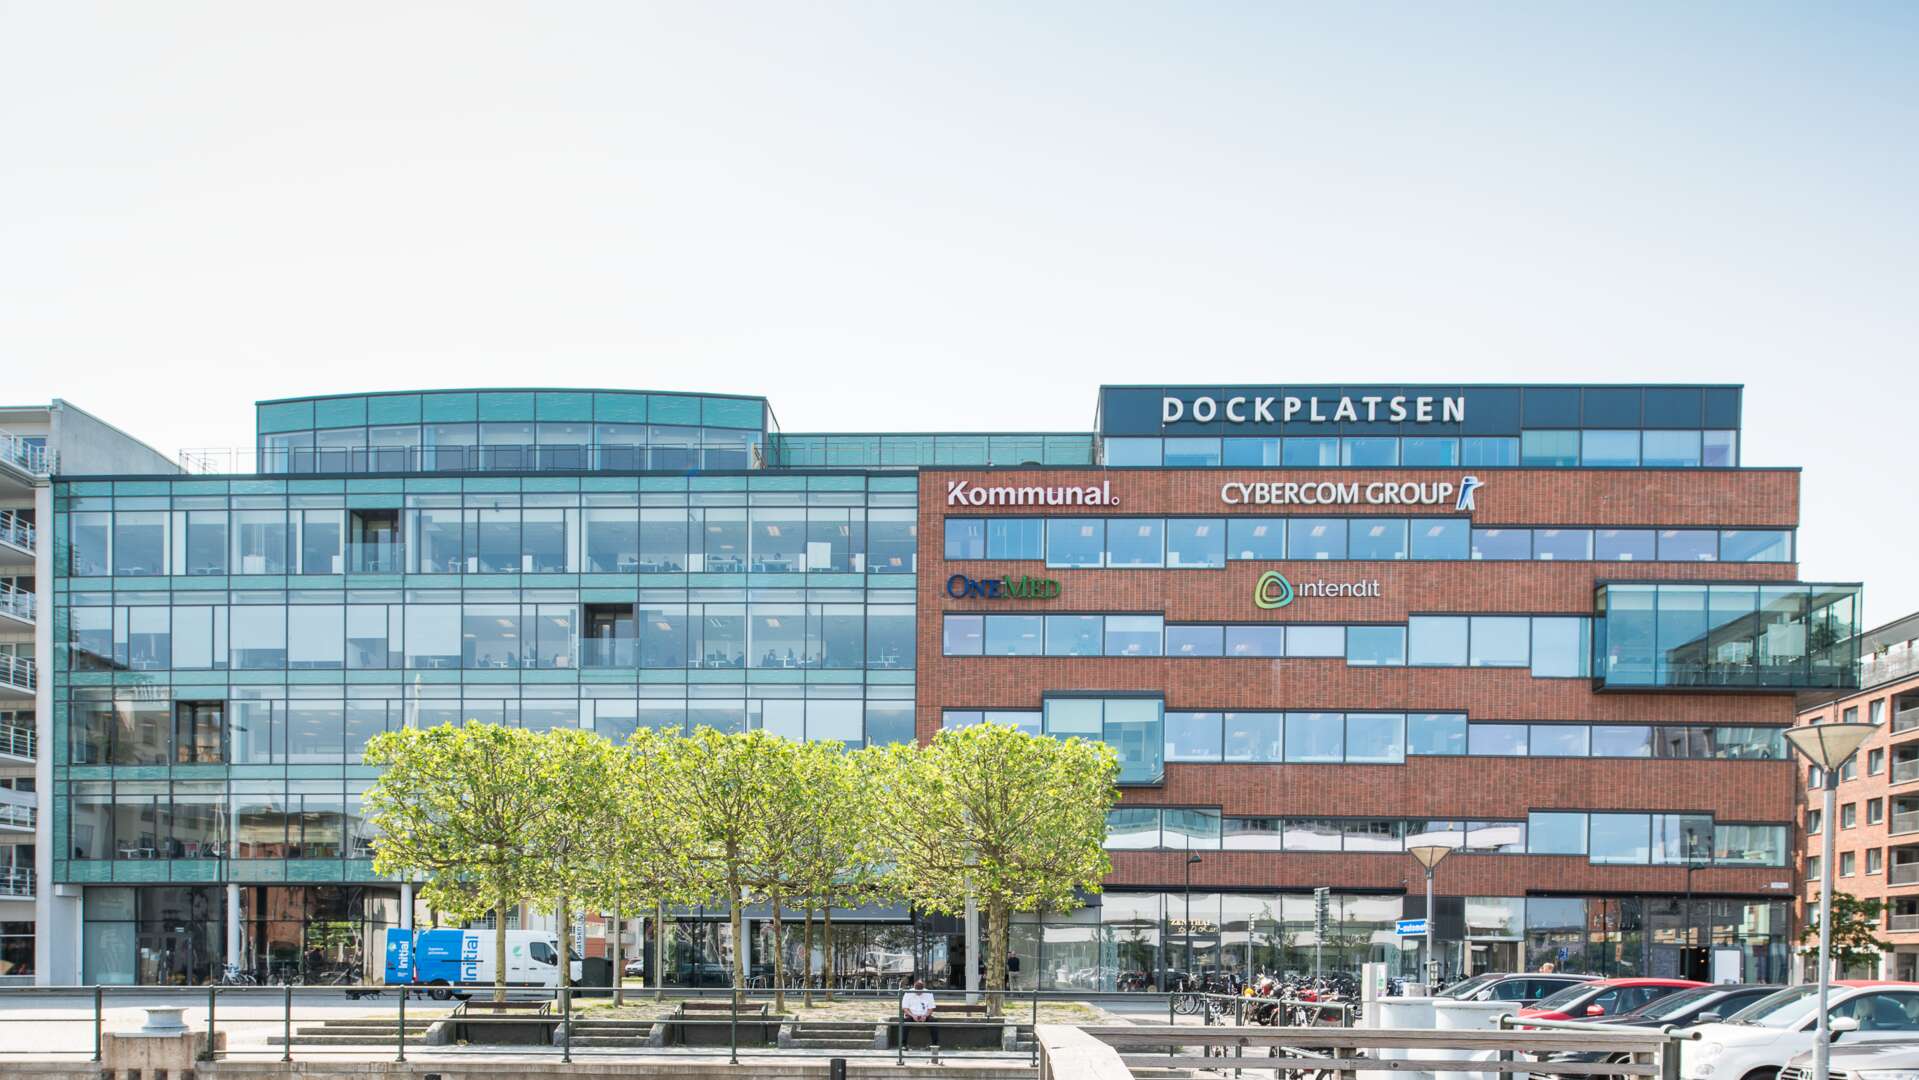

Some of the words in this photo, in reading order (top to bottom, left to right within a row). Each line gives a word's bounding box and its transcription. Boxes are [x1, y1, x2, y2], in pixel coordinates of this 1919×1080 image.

[1162, 396, 1465, 422] DOCKPLATSEN
[1221, 482, 1359, 505] CYBERCOM
[1365, 482, 1453, 505] GROUP
[1299, 579, 1381, 598] intendit
[397, 940, 409, 969] Initial
[463, 935, 479, 981] Initial
